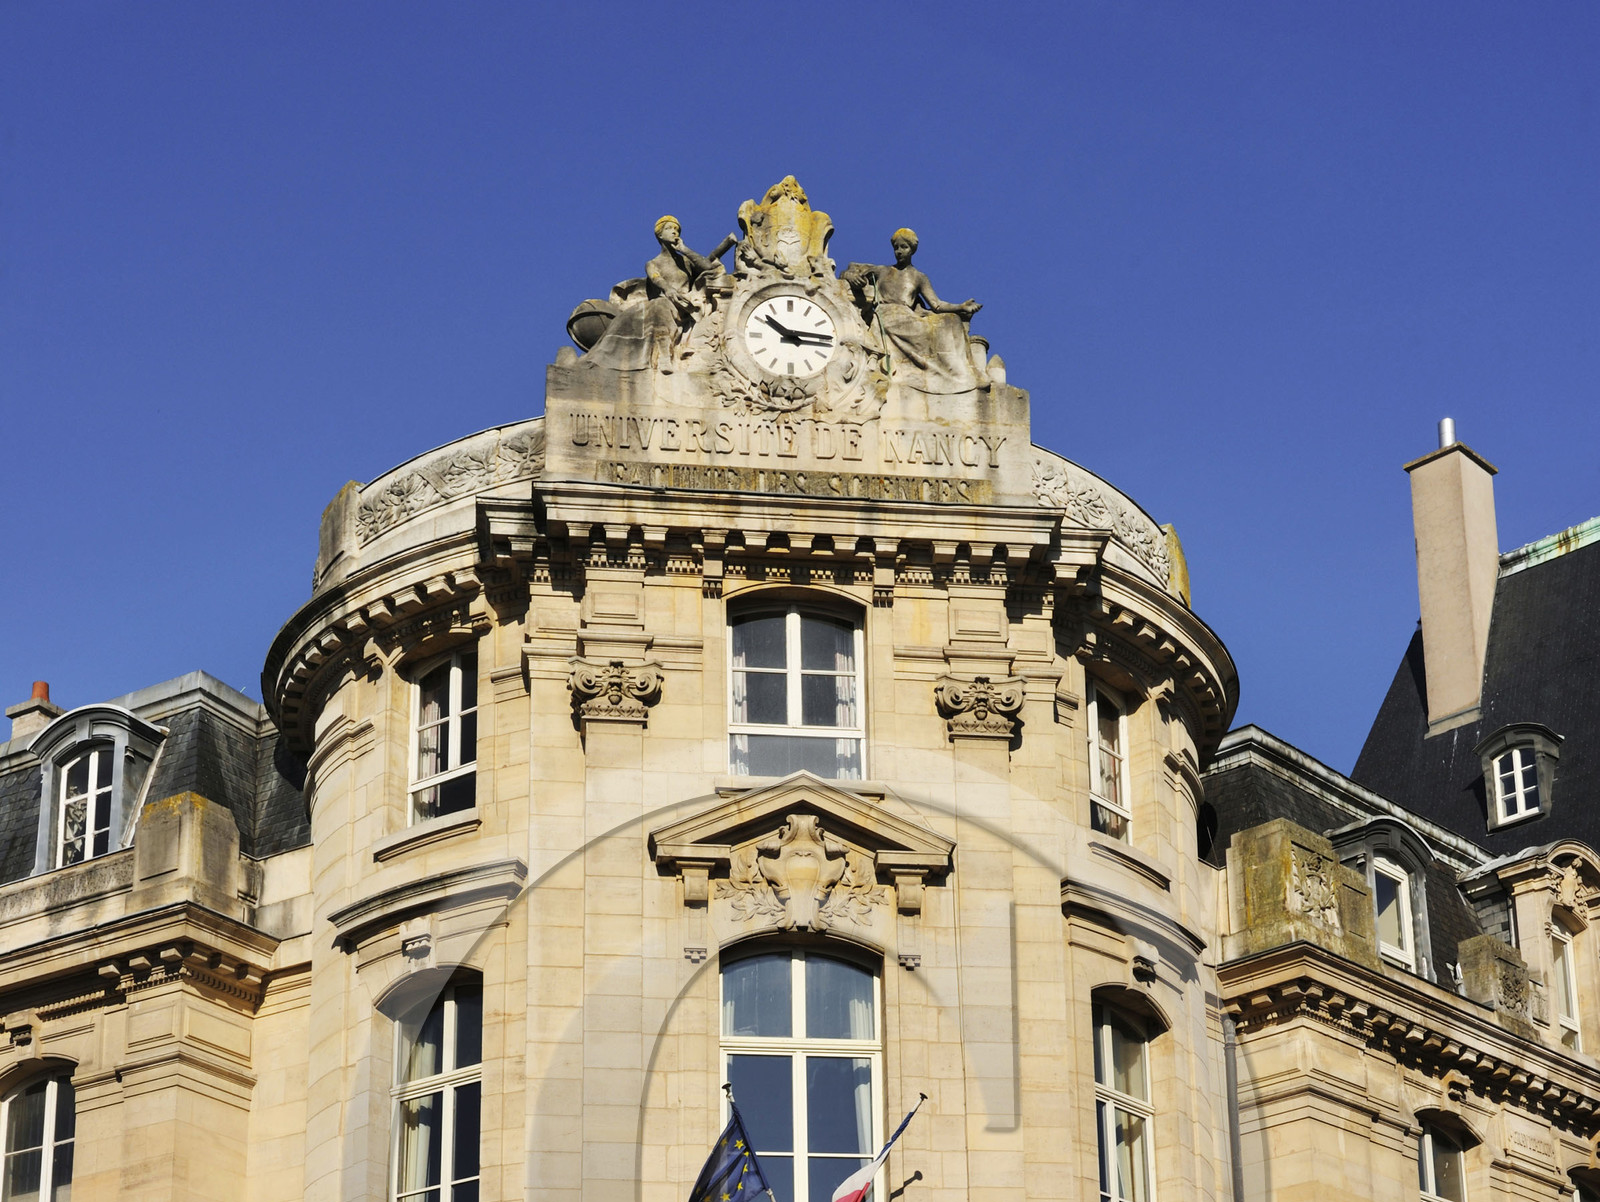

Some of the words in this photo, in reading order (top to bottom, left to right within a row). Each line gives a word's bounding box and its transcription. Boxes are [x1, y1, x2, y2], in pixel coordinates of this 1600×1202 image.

[570, 413, 799, 458] UNIVERSITÉ
[816, 426, 864, 462] DE
[883, 430, 1008, 468] NANCY
[828, 474, 973, 503] SCIENCES
